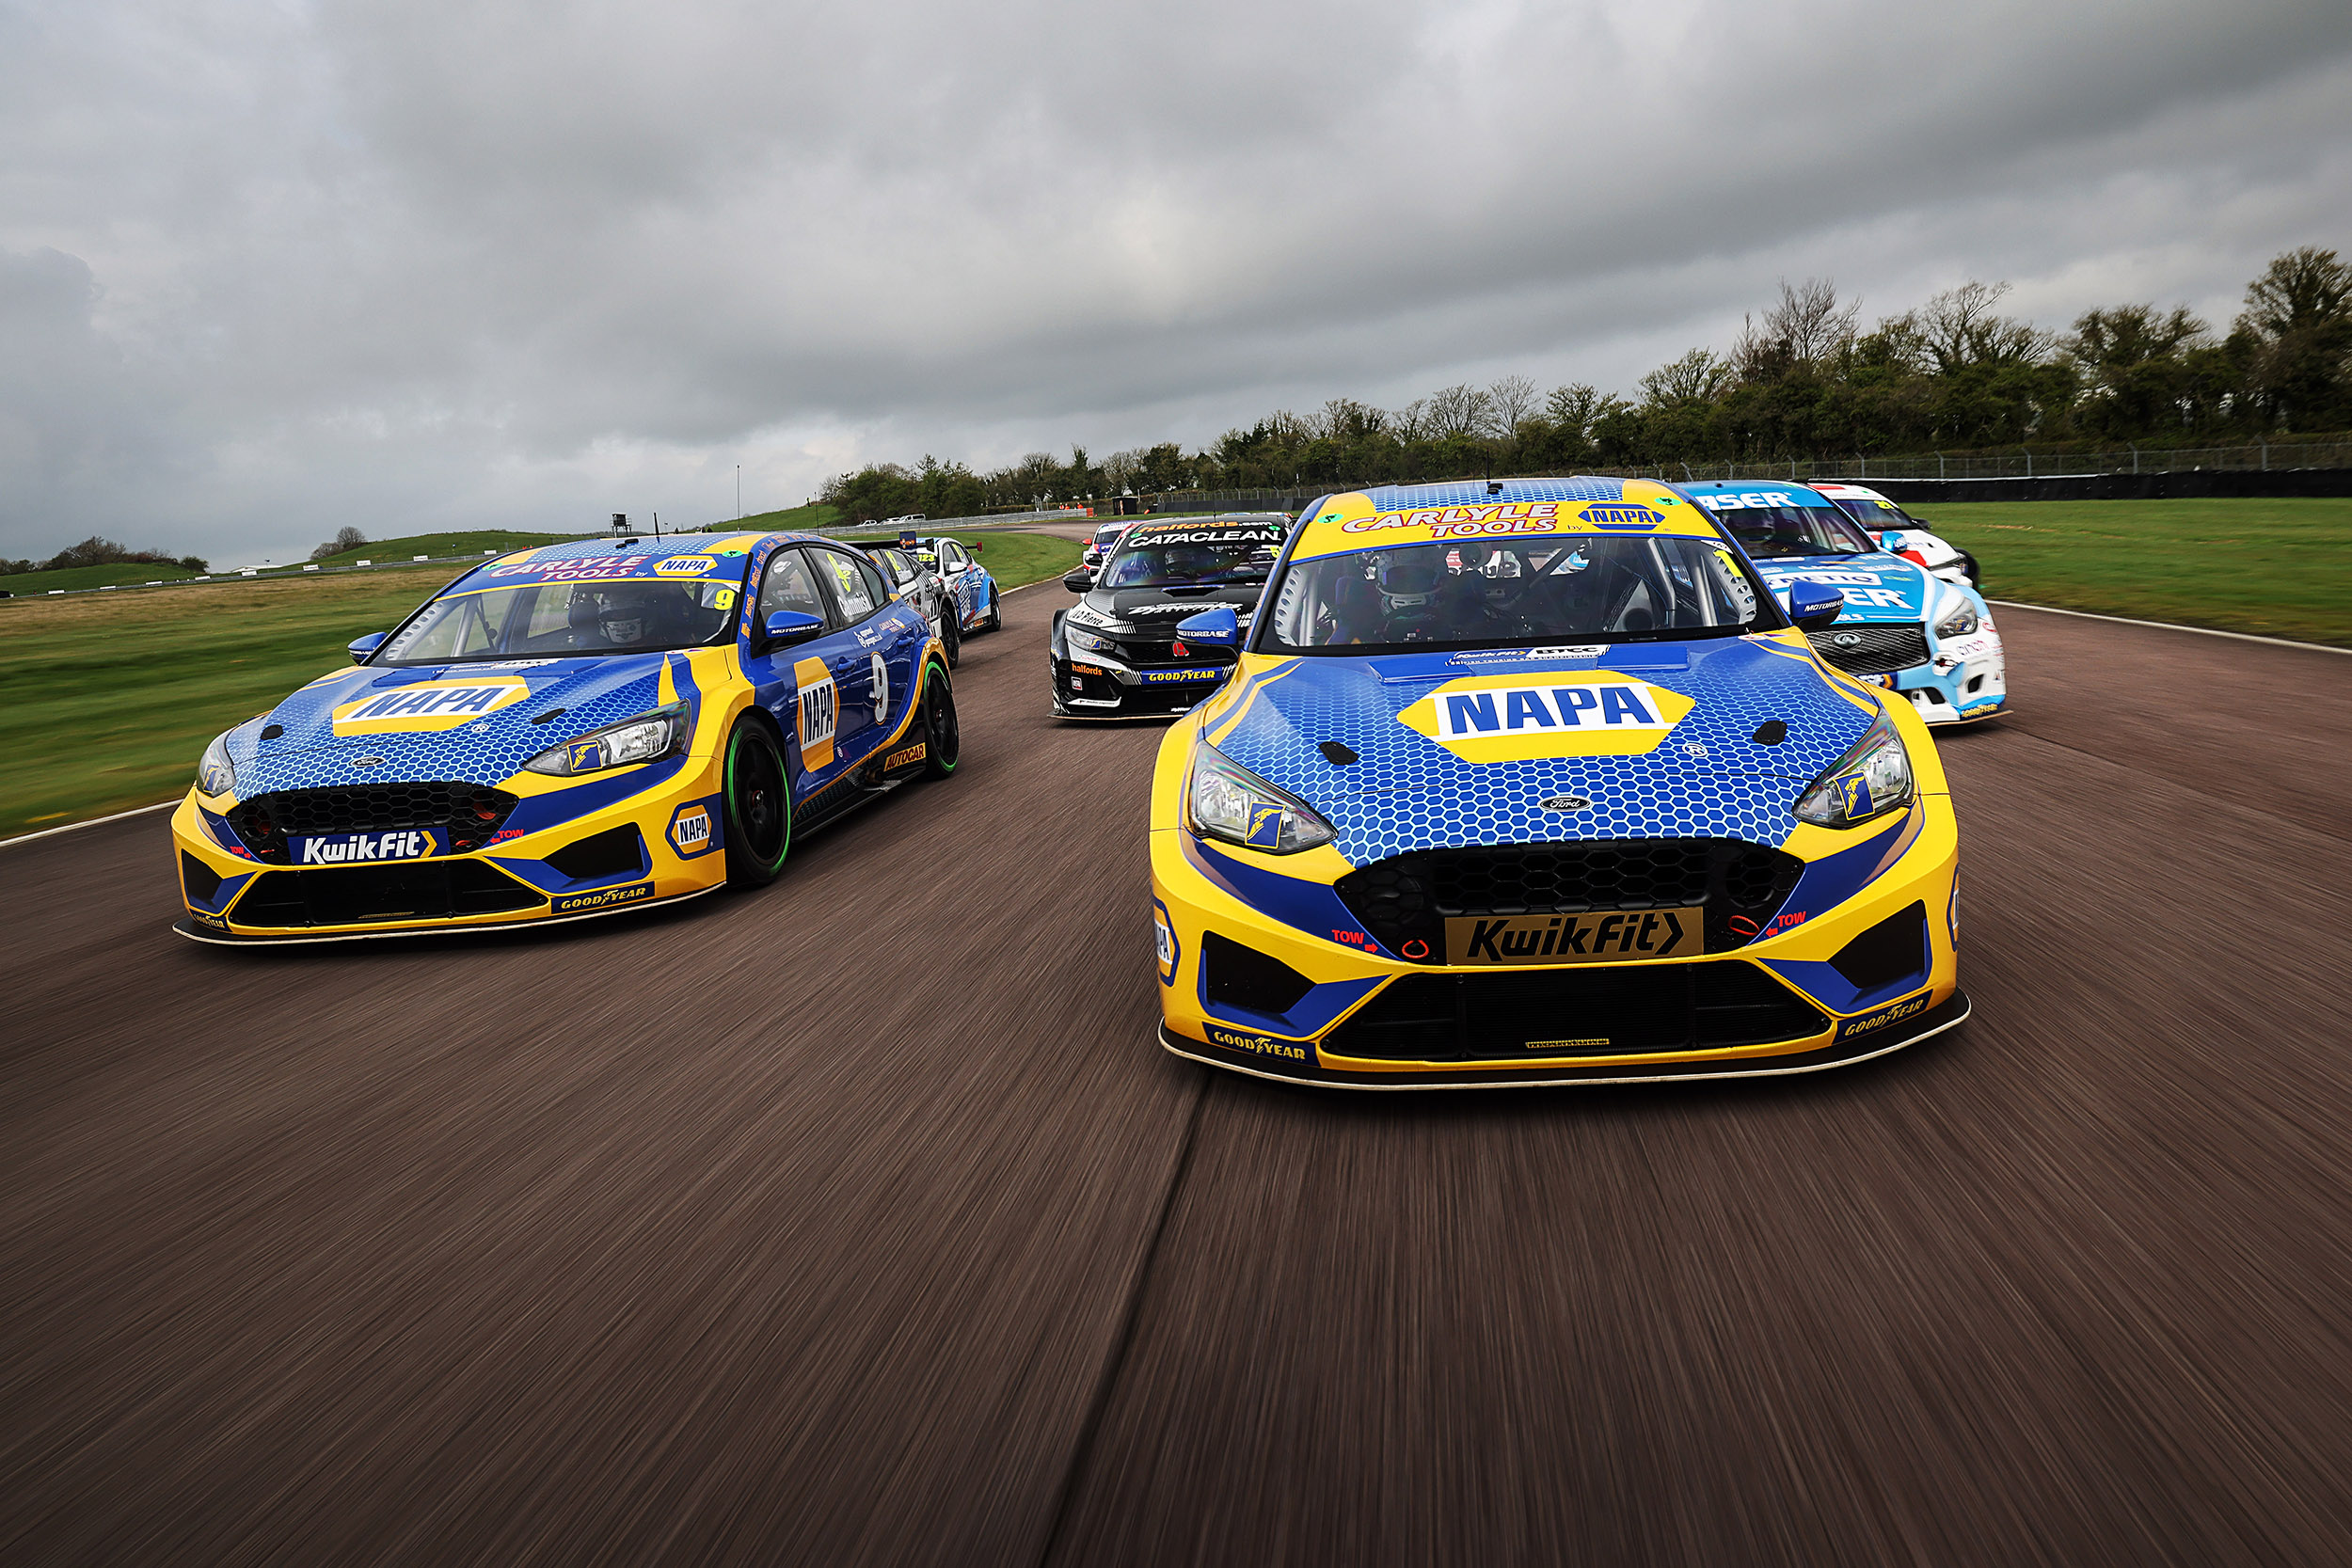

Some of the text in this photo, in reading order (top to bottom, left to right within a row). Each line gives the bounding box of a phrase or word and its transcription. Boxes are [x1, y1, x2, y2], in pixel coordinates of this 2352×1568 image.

[1138, 521, 1273, 533] halfords.com
[1343, 504, 1559, 533] CARLYLE
[1432, 509, 1654, 537] TOOLS by NAPA
[1129, 530, 1278, 547] CATACLEAN
[489, 555, 651, 578] CARLYLE
[538, 566, 636, 581] TOOLS
[660, 560, 709, 571] NAPA
[1713, 550, 1742, 578] 1
[713, 589, 736, 610] 9
[771, 624, 819, 634] MOTORBASE
[1072, 663, 1103, 675] halfords
[1149, 669, 1216, 682] GOODYEAR
[871, 652, 888, 724] 9
[351, 688, 506, 719] NAPA
[802, 683, 835, 745] NAPA
[1446, 687, 1656, 735] NAPA
[886, 745, 924, 769] AUTOCAR
[1549, 798, 1581, 809] Ford
[497, 829, 524, 839] TOW
[679, 816, 708, 843] NAPA
[230, 846, 245, 855] TOW
[561, 887, 646, 911] GOODYEAR
[1777, 911, 1806, 927] TOW
[1331, 929, 1364, 945] TOW
[1845, 999, 1924, 1036] GOODYEAR
[1214, 1031, 1307, 1061] GOODYEAR
